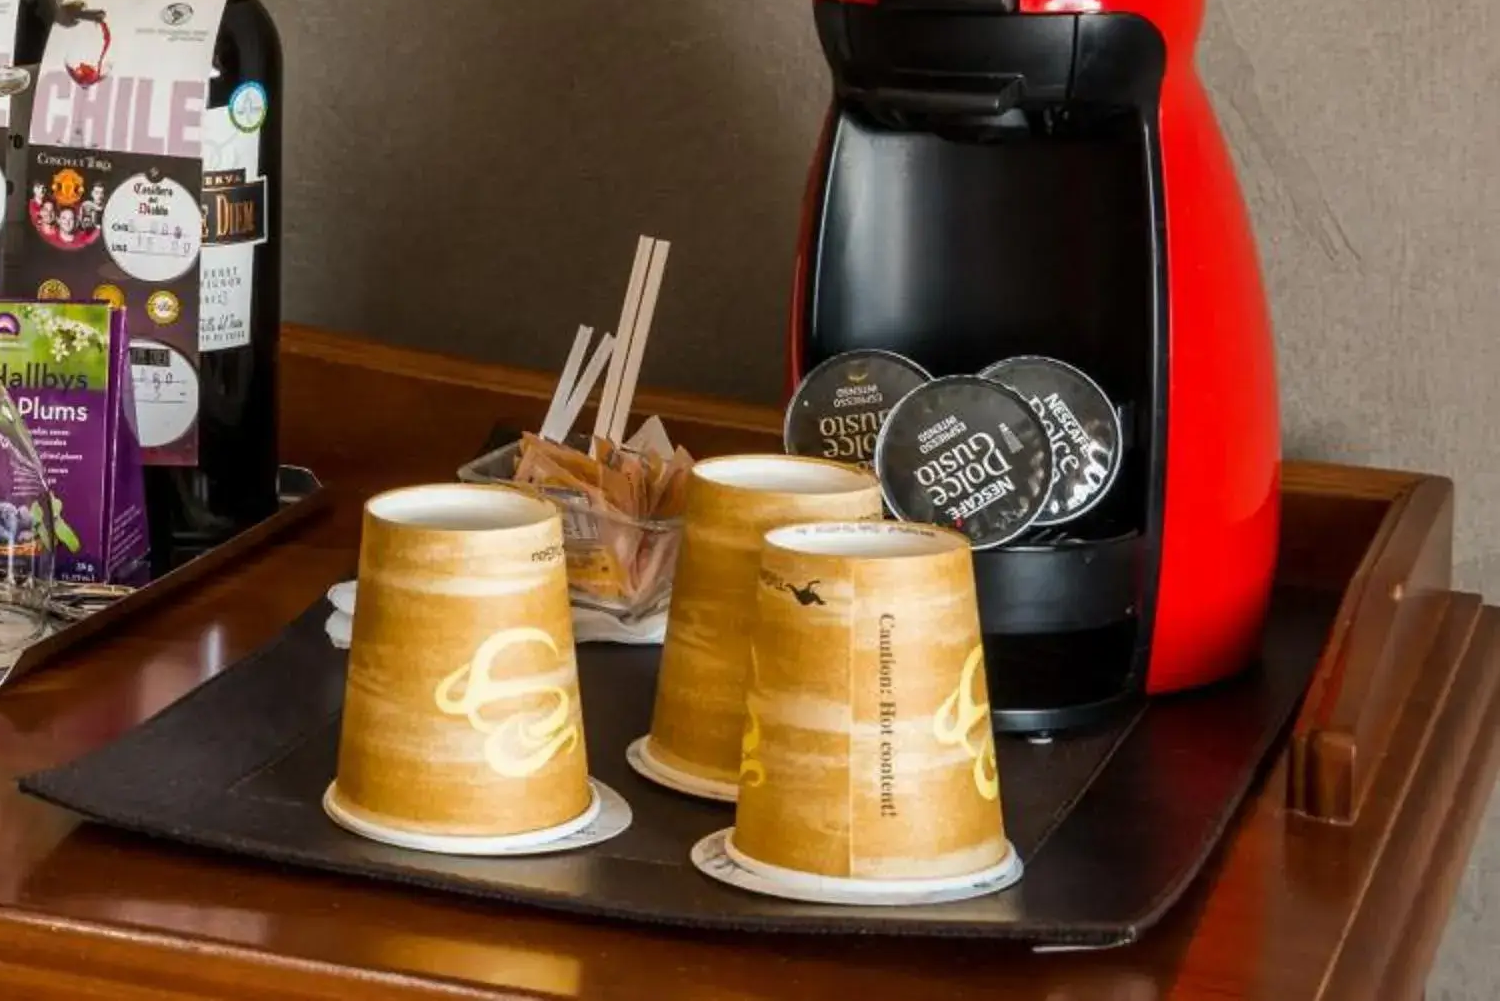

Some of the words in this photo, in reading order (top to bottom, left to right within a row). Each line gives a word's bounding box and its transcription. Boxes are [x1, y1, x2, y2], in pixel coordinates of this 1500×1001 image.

[29, 69, 203, 158] CHILE
[18, 396, 88, 422] Plums
[822, 433, 879, 459] olce
[916, 432, 995, 487] Gusto
[926, 448, 1013, 506] Dolce
[879, 702, 897, 735] Hot
